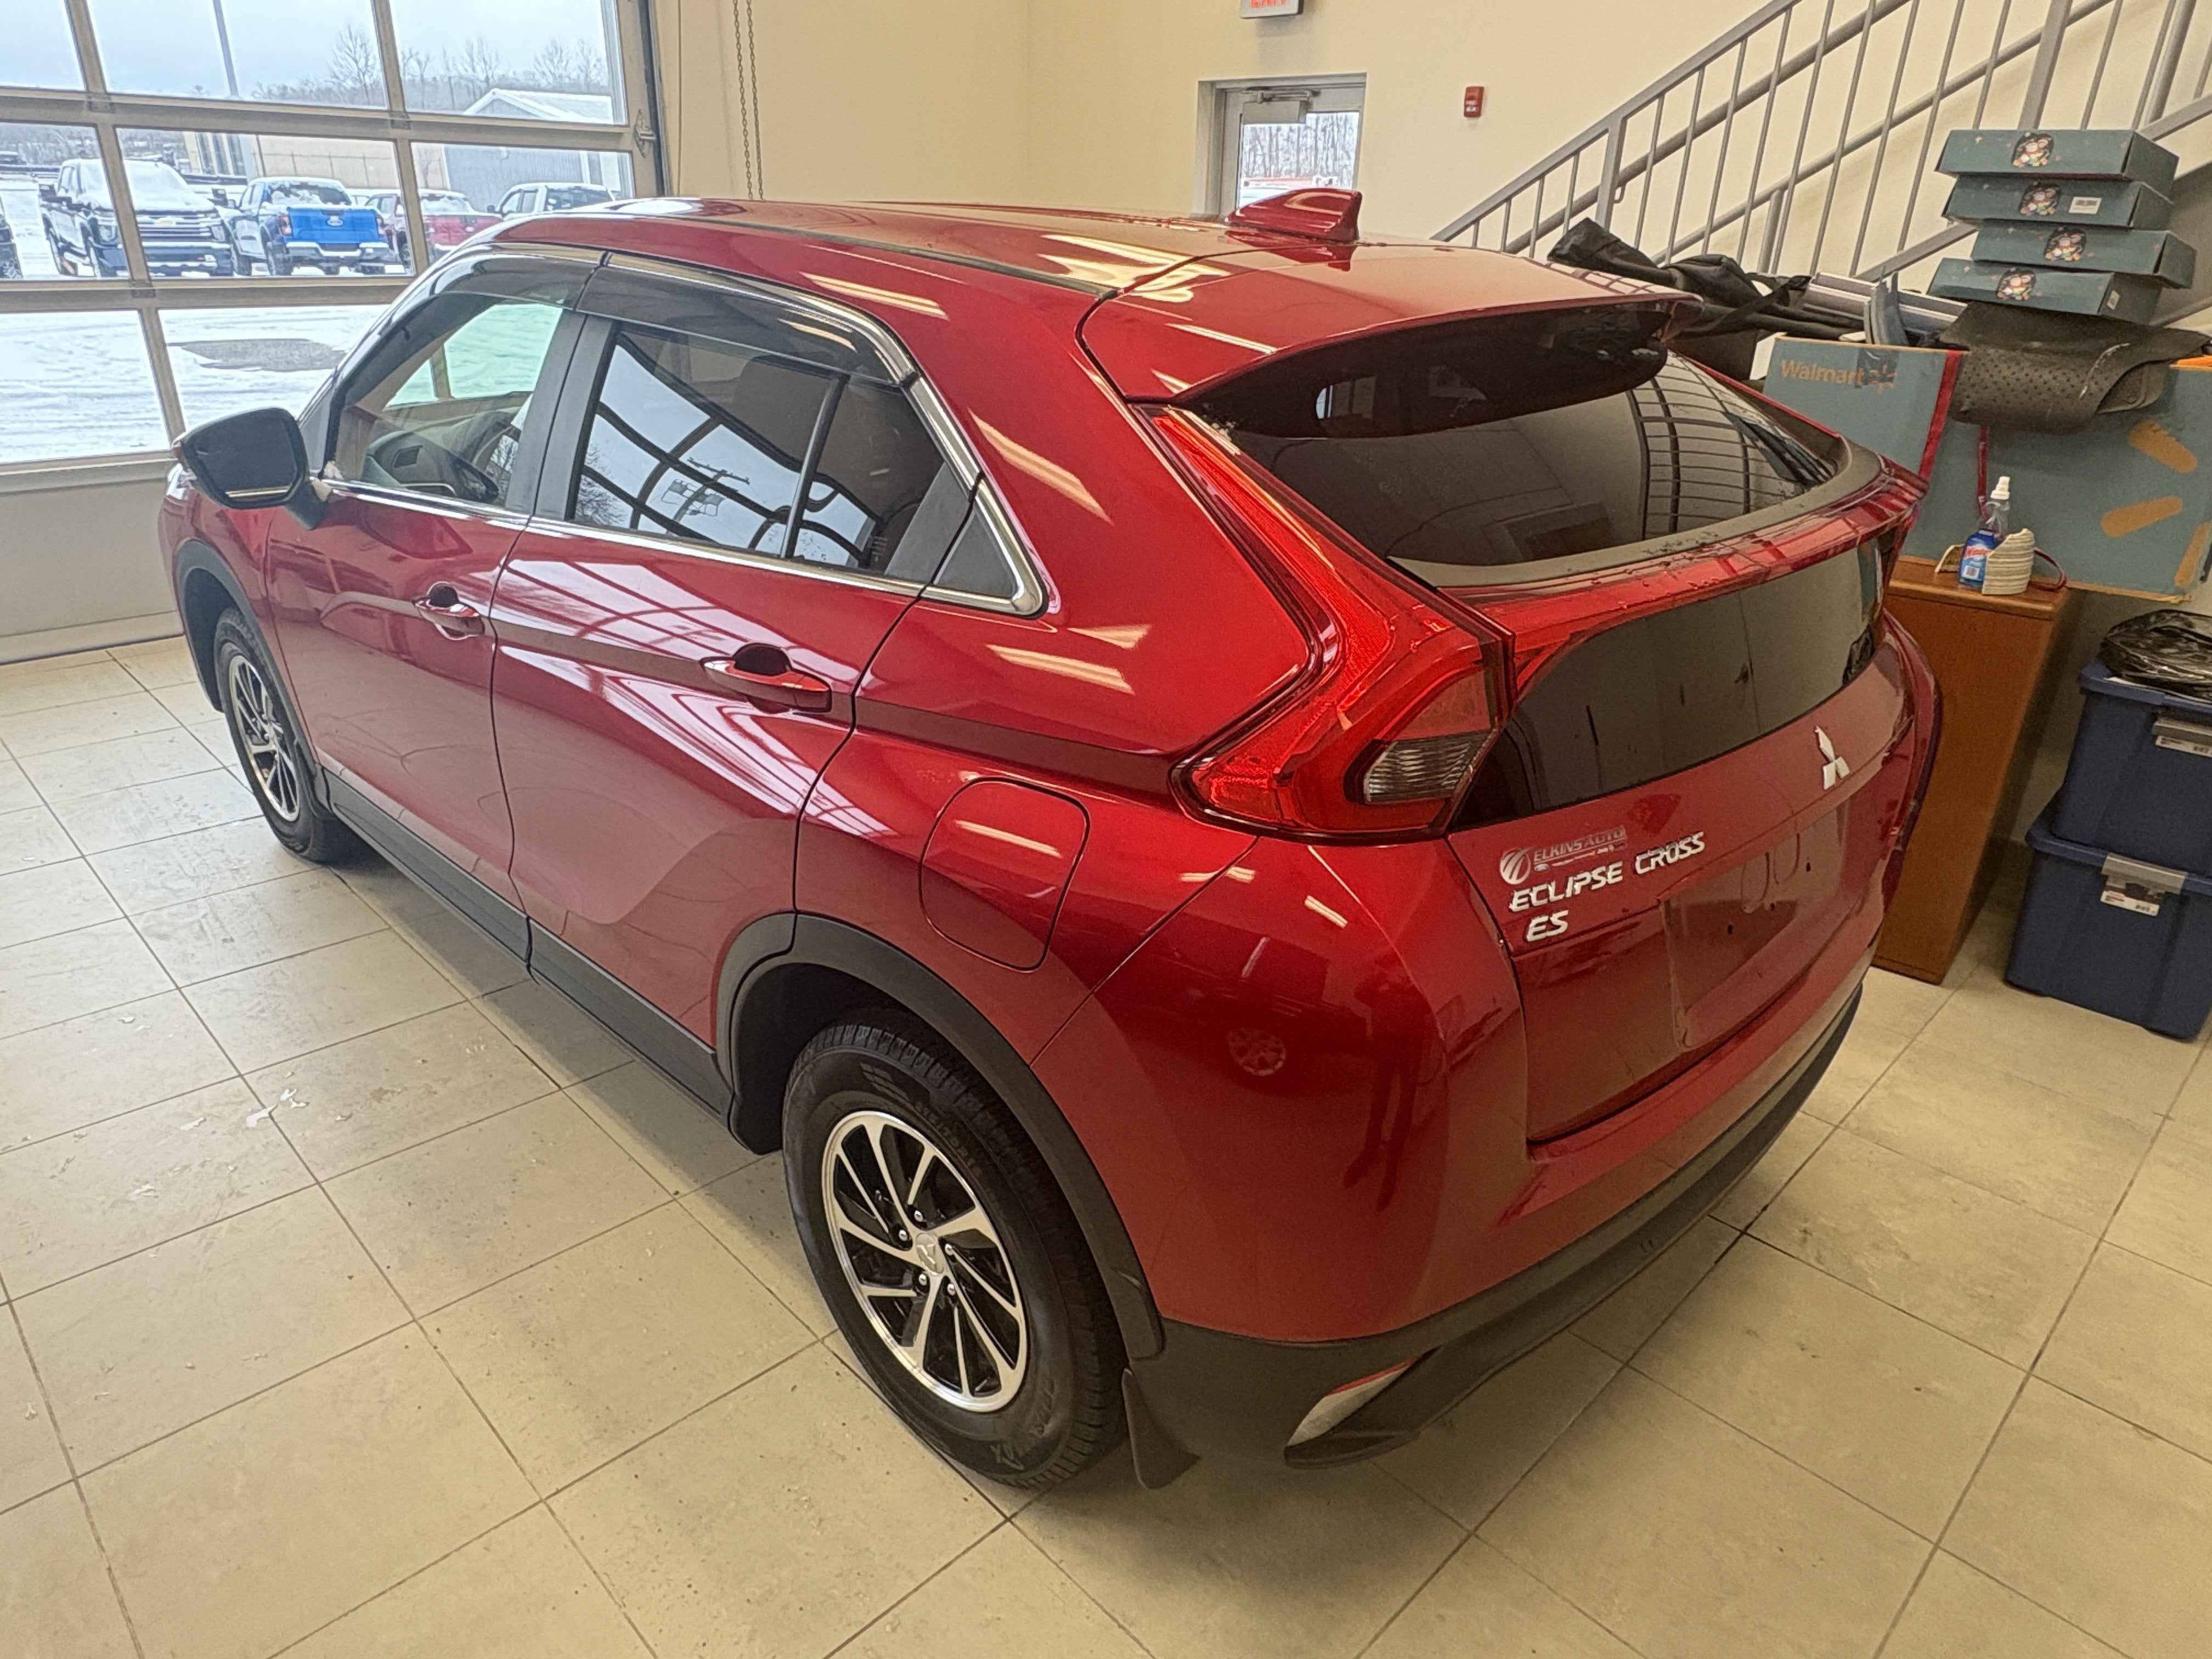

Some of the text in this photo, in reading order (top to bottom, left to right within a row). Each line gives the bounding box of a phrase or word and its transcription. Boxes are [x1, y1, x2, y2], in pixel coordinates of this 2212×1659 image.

[1781, 359, 1865, 386] Walmart
[1534, 839, 1582, 861] ELKINS
[1584, 826, 1626, 847] AUTO
[1509, 861, 1623, 912] ECLIPSE
[1635, 831, 1705, 875] CROSS
[1526, 910, 1569, 942] ES
